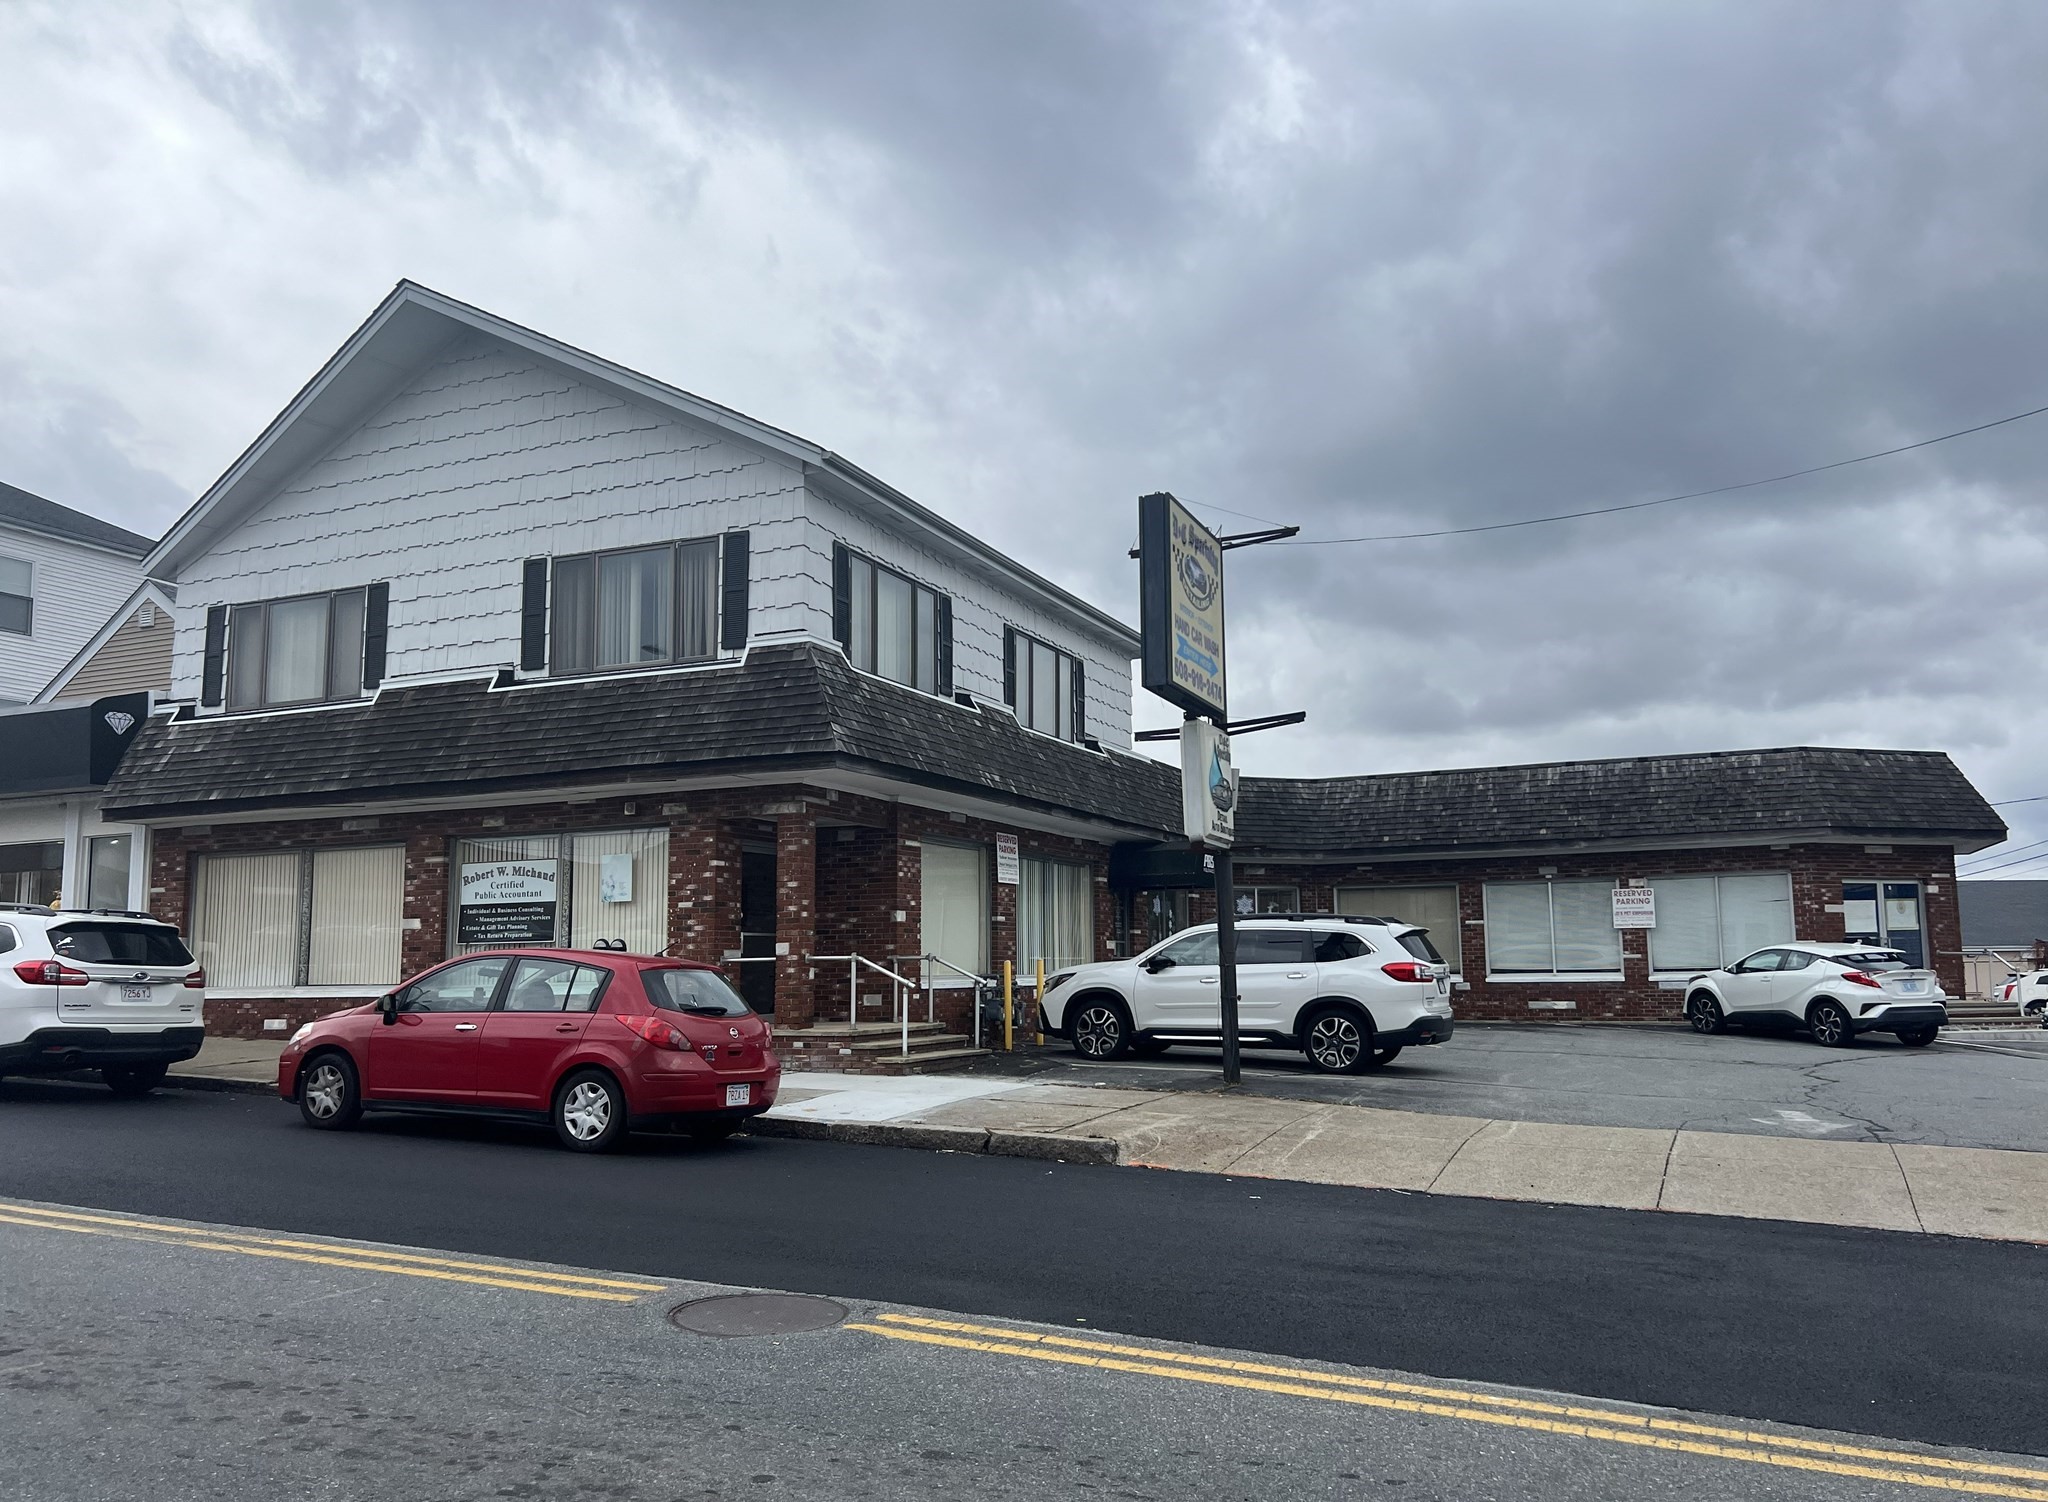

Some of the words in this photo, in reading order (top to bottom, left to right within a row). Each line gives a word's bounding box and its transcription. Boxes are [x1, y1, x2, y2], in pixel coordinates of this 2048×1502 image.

[1175, 613, 1190, 637] HAND
[1191, 626, 1203, 648] CAR
[1204, 634, 1219, 658] WASH
[462, 868, 495, 887] Robert
[496, 866, 509, 877] W.
[512, 866, 556, 882] Michaud
[490, 880, 525, 890] Certified
[474, 891, 497, 900] Public
[499, 890, 542, 899] Accountant
[1615, 897, 1651, 905] PARKING
